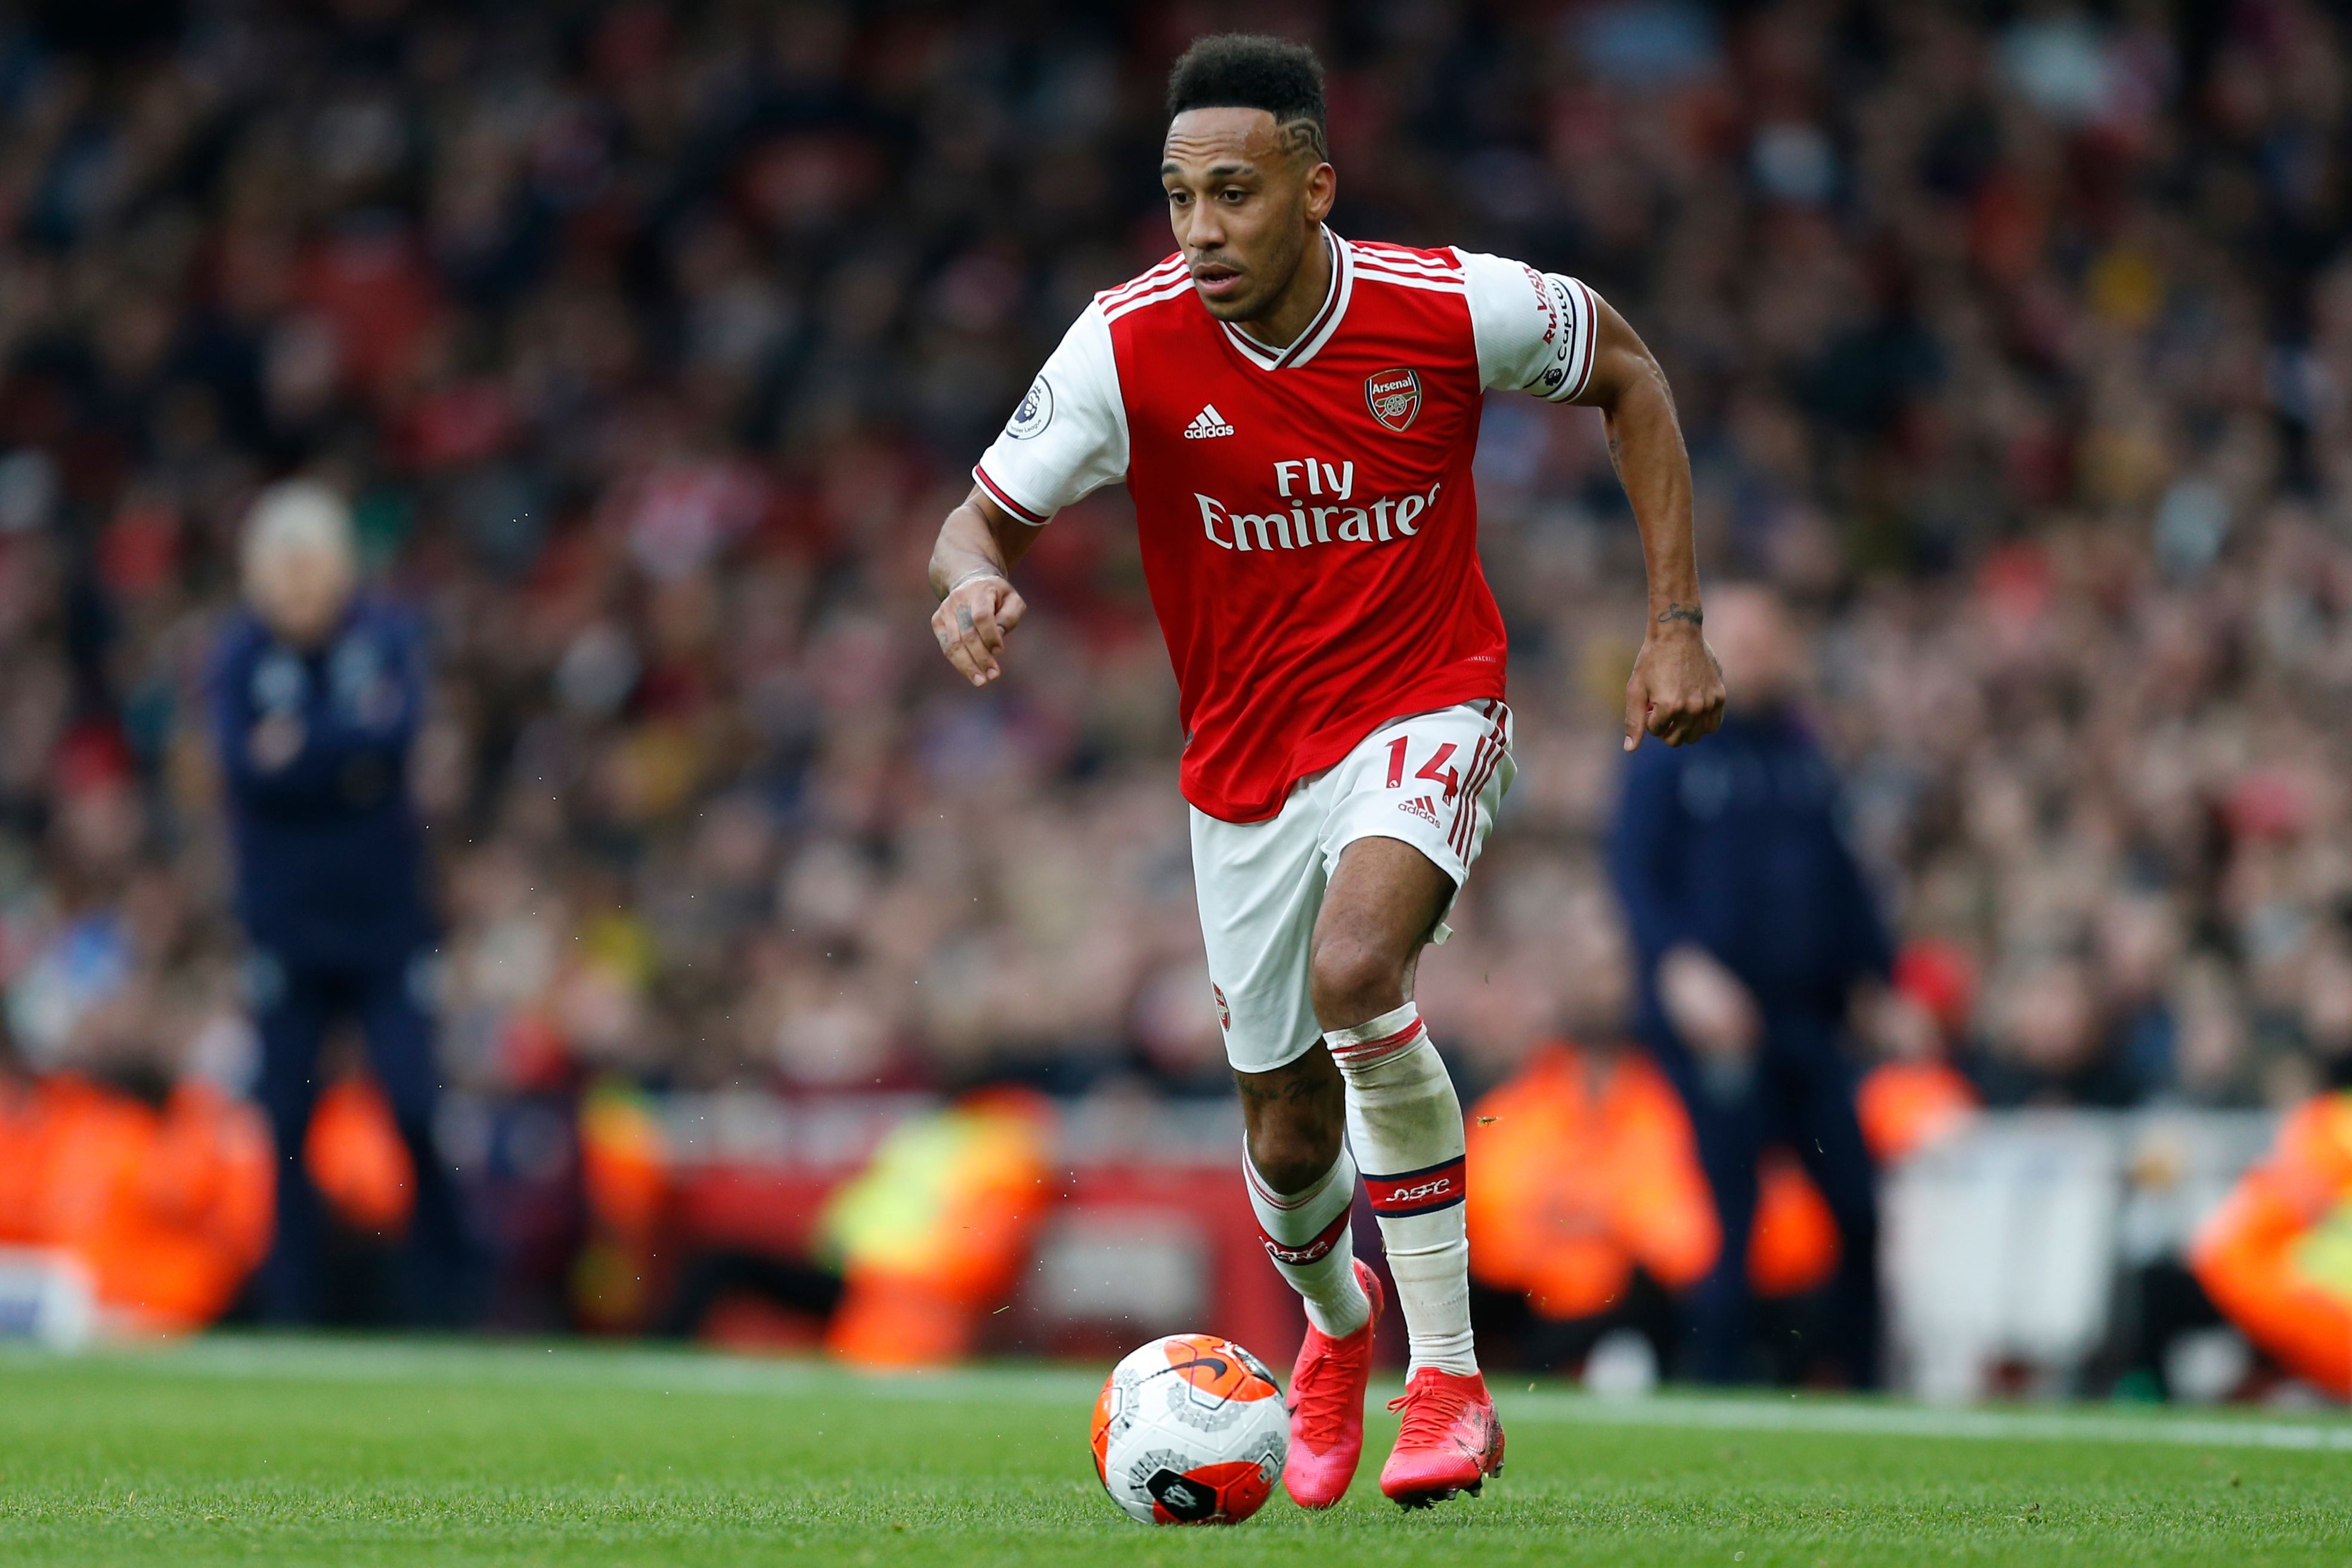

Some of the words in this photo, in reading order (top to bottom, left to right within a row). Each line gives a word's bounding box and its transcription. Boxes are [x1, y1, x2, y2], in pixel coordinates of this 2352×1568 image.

[1523, 267, 1548, 311] VISIT
[1372, 376, 1412, 395] Arsenal
[1184, 424, 1234, 439] adidas
[1273, 458, 1354, 500] Fly
[1384, 735, 1459, 808] 14
[1398, 803, 1440, 829] adidas
